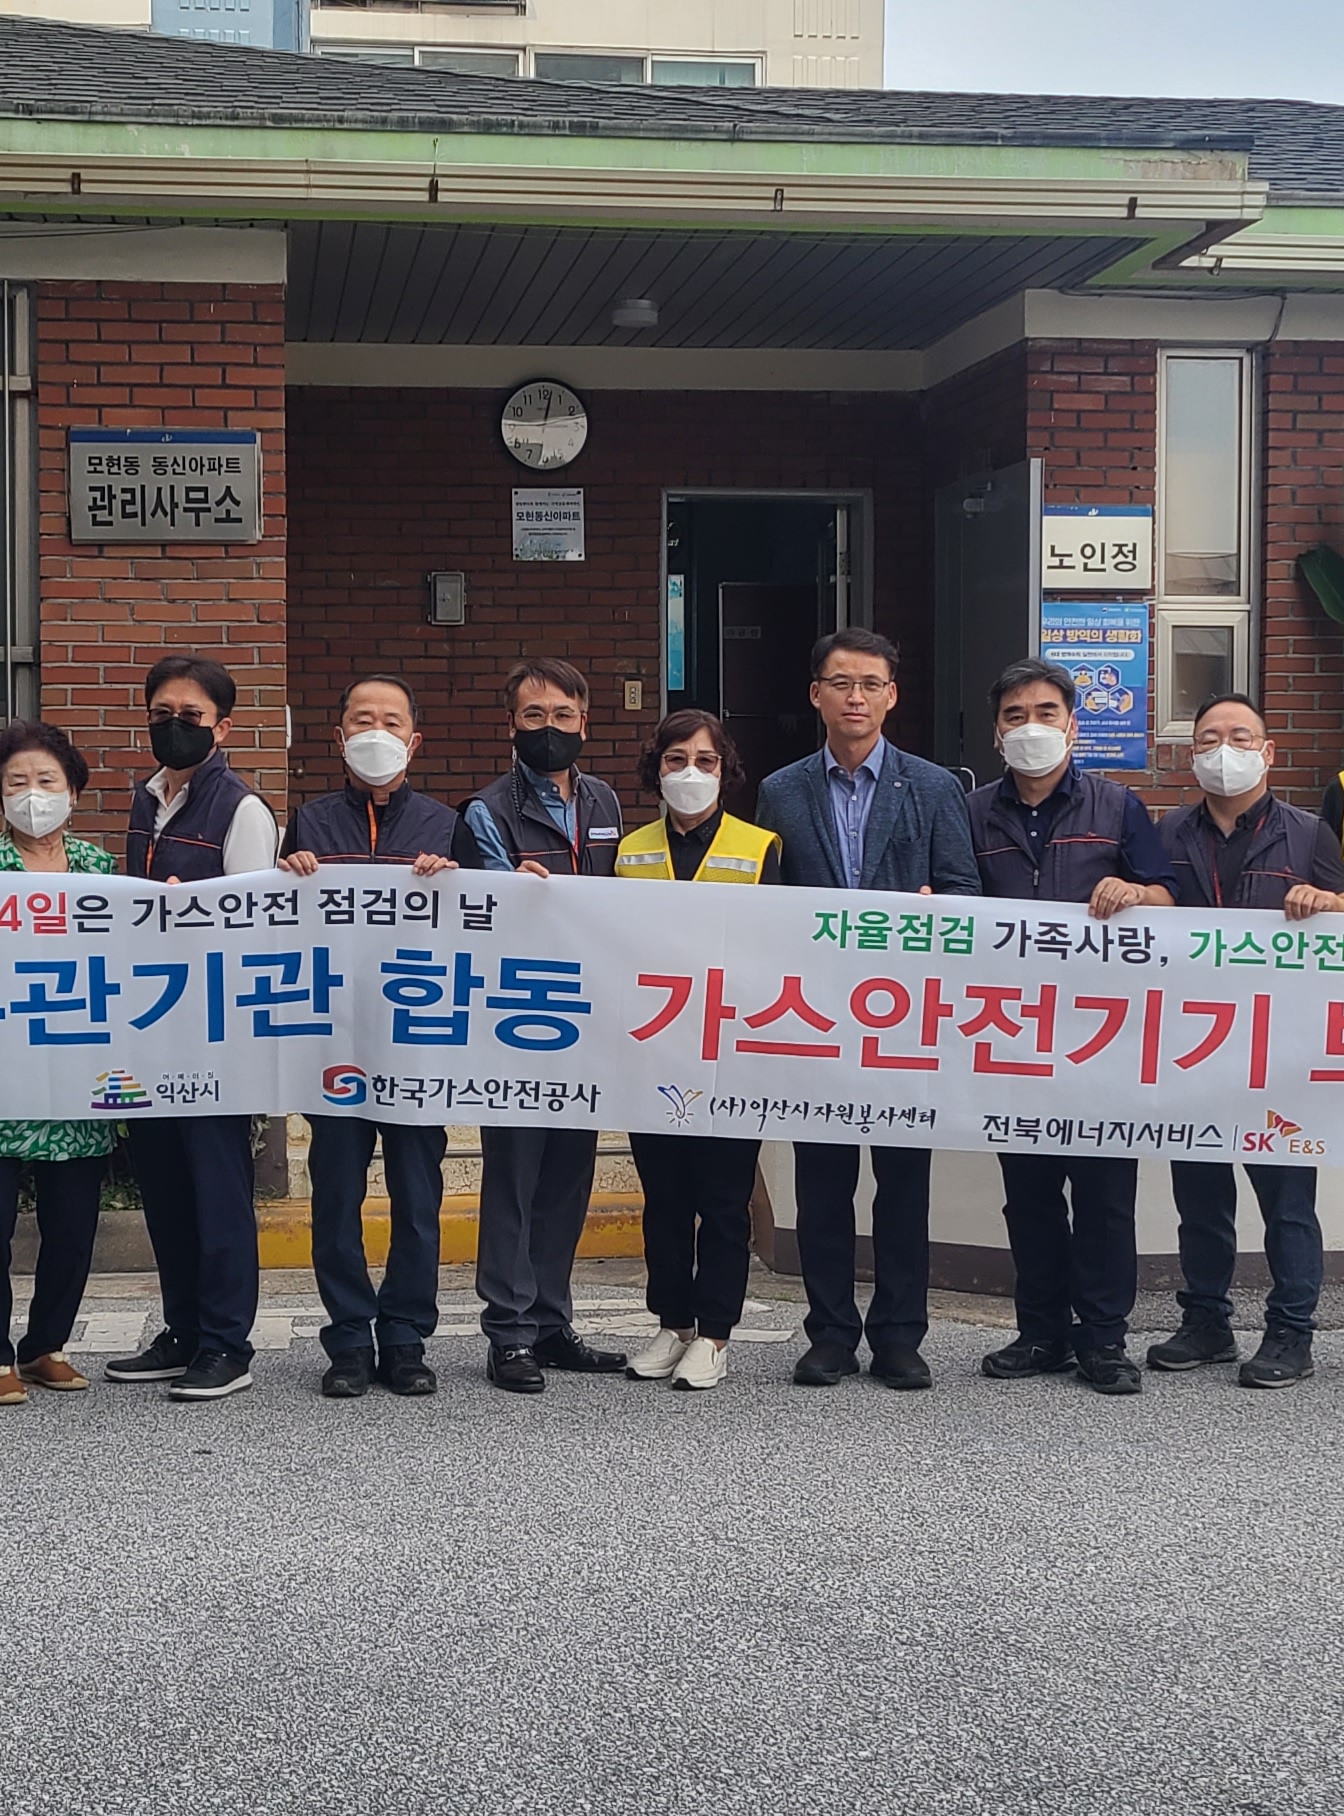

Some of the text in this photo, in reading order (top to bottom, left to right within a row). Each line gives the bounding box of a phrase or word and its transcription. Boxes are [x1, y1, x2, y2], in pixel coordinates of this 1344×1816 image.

[512, 406, 523, 417] 10
[568, 405, 576, 416] 2
[86, 455, 242, 476] 모현동 동신아파트
[526, 449, 533, 459] 7
[87, 483, 243, 528] 관리사무소
[1046, 541, 1139, 573] 노인정
[1066, 629, 1103, 643] 방역의
[131, 888, 301, 933] 가스안전
[317, 887, 440, 929] 점검의
[458, 893, 498, 932] 날
[811, 909, 976, 955] 자율점검
[992, 921, 1169, 968] 가족사랑,
[379, 948, 592, 1052] 합동
[627, 967, 1273, 1090] 가스안전기기
[155, 1079, 220, 1104] 익산시
[371, 1074, 602, 1114] 한국가스안전공사
[982, 1114, 1224, 1150] 전북에너지서비스
[1242, 1131, 1325, 1155] SK E&S
